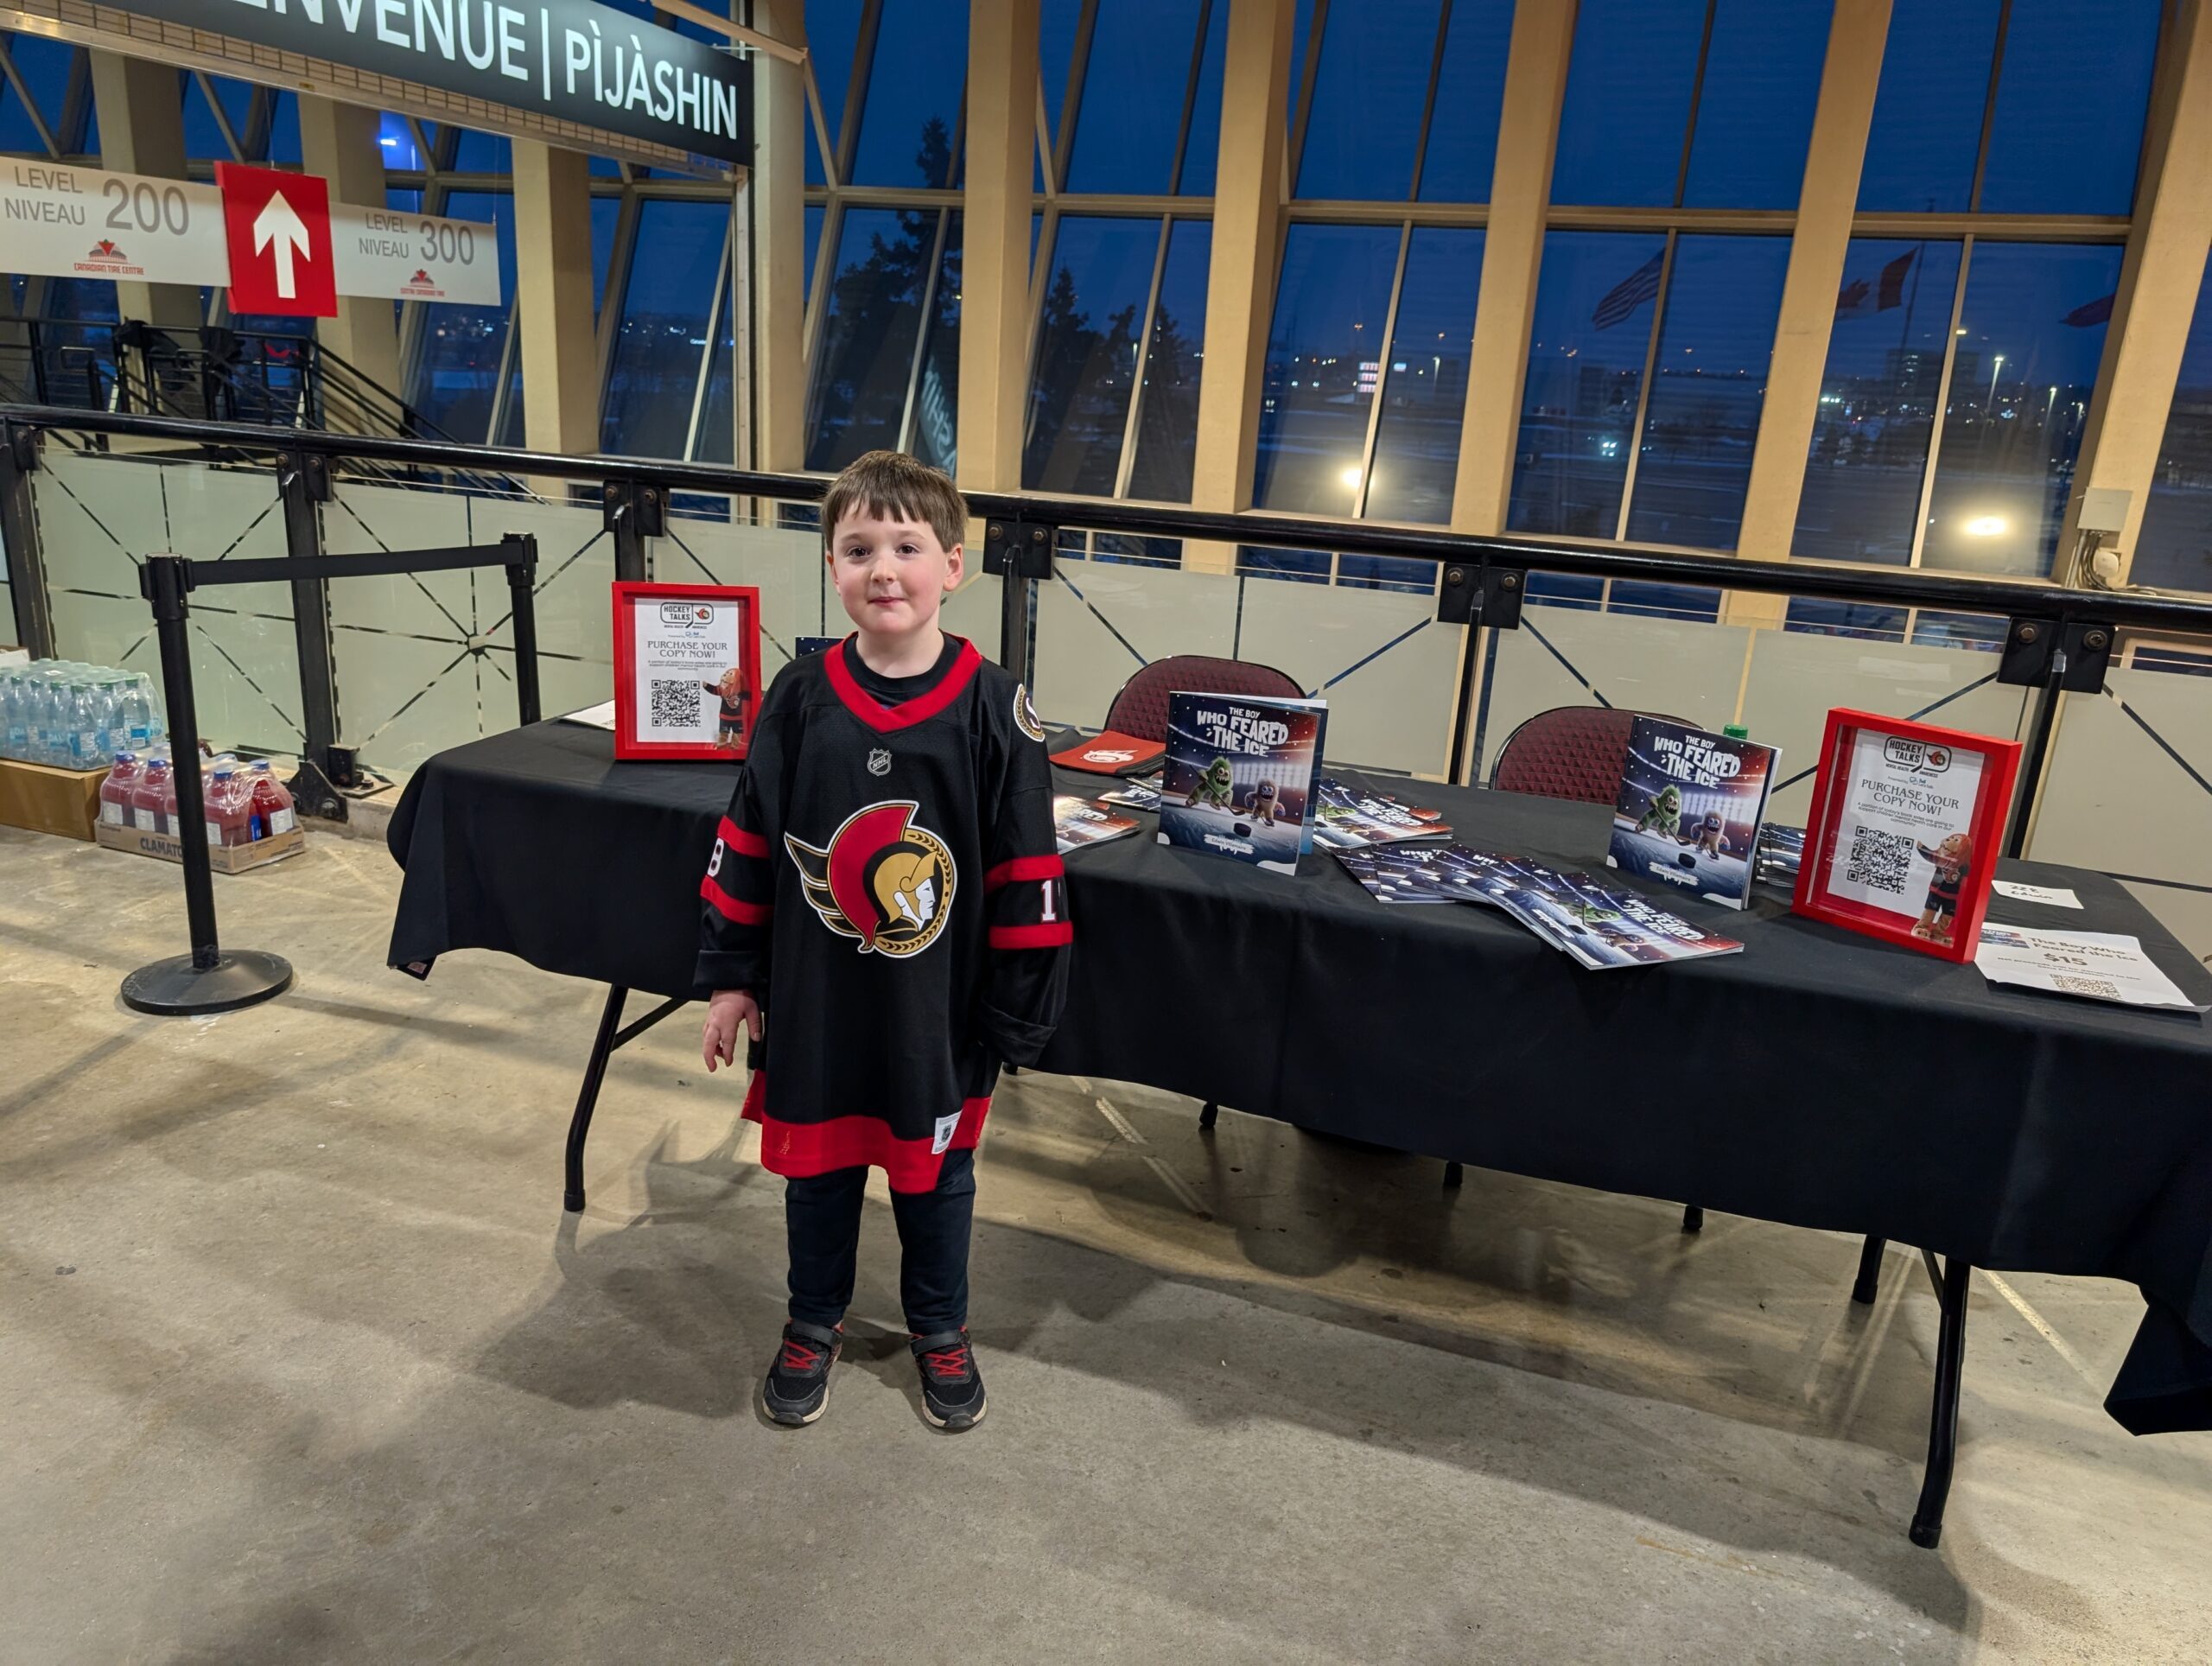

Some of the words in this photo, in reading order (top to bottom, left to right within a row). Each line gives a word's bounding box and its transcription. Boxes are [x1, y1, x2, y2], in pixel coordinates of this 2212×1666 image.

[565, 19, 737, 140] PÌJÀSHIN
[15, 166, 83, 194] LEVEL
[4, 198, 86, 226] NIVEAU
[103, 179, 189, 236] 200
[365, 213, 408, 233] LEVEL
[359, 238, 409, 258] NIVEAU
[420, 220, 474, 265] 300
[74, 263, 106, 272] CANADIAN
[107, 265, 121, 274] TIRE
[122, 266, 144, 275] CENTRE
[647, 640, 699, 649] PURCHASE
[1229, 707, 1244, 716] THE
[1245, 709, 1261, 719] BOY
[1197, 710, 1227, 726] WHO
[1230, 715, 1289, 745] FEARED
[1212, 726, 1242, 752] THE
[1244, 738, 1269, 757] ICE
[1685, 734, 1700, 746] THE
[1700, 739, 1716, 749] BOY
[1889, 740, 1923, 754] HOCKEY
[873, 757, 887, 769] NHL
[1654, 736, 1683, 754] WHO
[1684, 744, 1741, 778] FEARED
[1895, 751, 1921, 763] TALKS
[1667, 753, 1694, 781] THE
[1694, 768, 1720, 789] ICE
[1861, 779, 1923, 800] PURCHASE
[1926, 793, 1960, 809] YOUR
[1873, 792, 1906, 807] COPY
[1909, 800, 1942, 816] NOW!
[1624, 900, 1656, 913] WHO
[1650, 914, 1705, 940] FEARED
[2033, 943, 2085, 954] Feared
[2044, 952, 2088, 966] $15
[2088, 945, 2126, 954] Who
